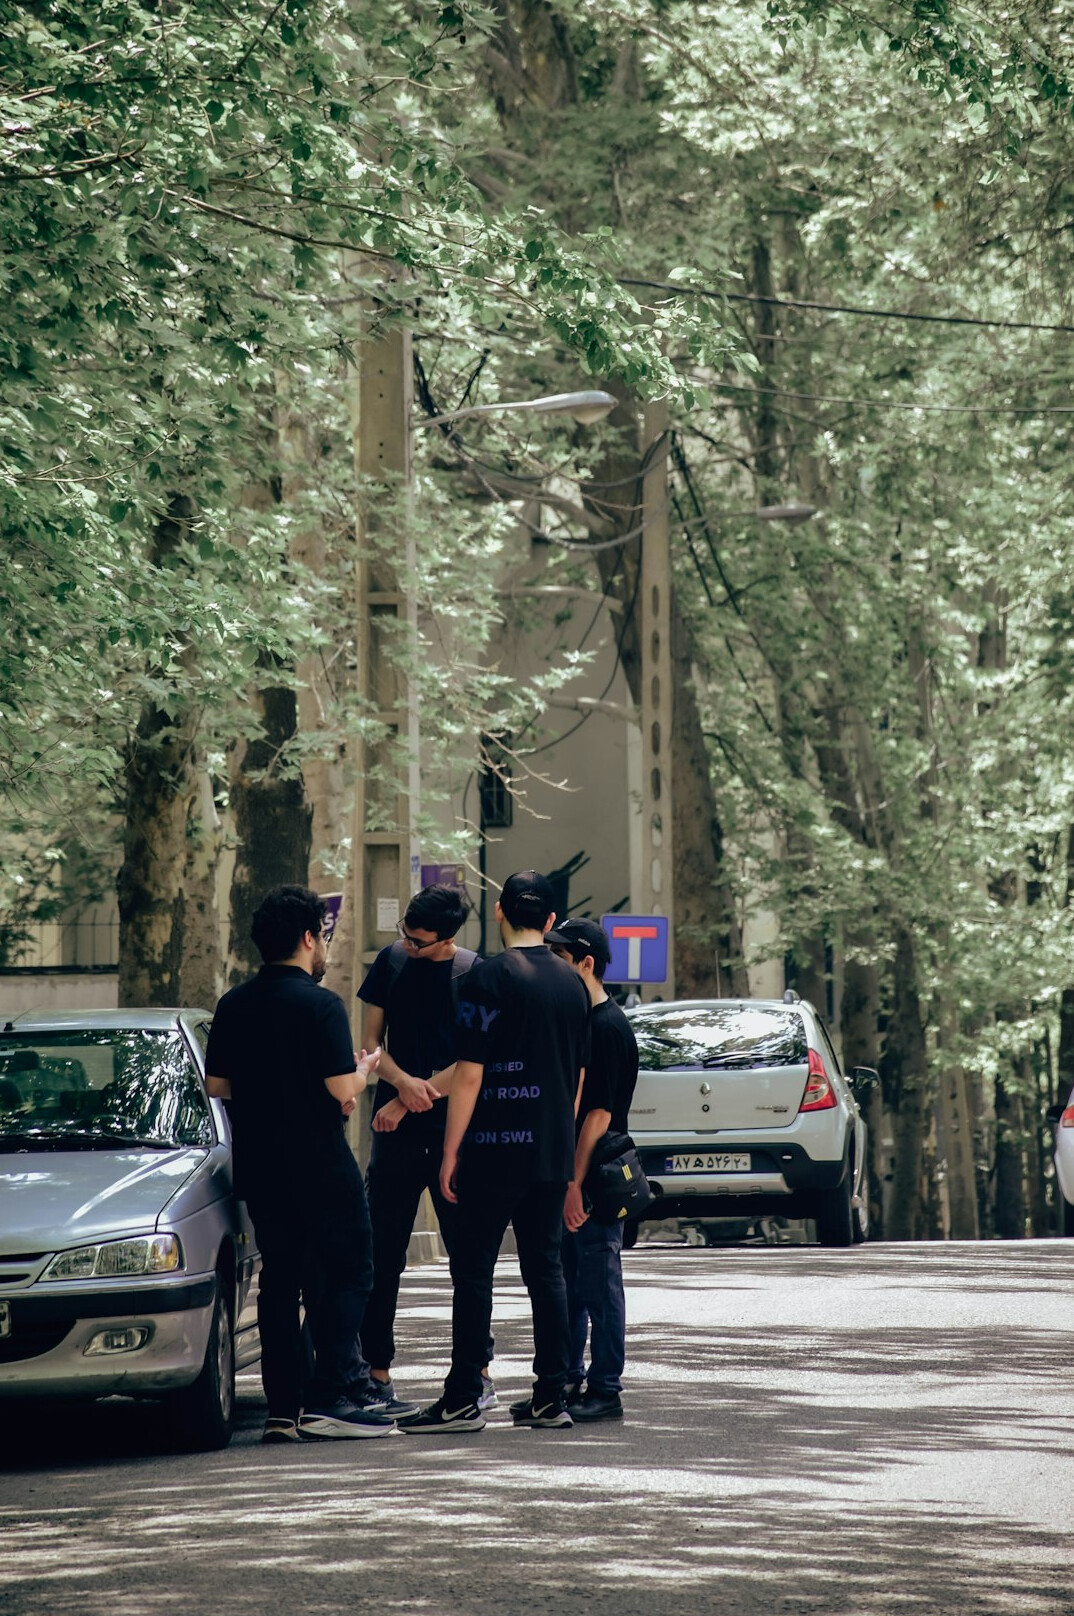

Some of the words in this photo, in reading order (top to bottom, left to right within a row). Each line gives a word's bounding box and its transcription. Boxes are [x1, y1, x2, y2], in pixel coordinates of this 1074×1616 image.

[497, 1085, 541, 1100] ROAD
[474, 1131, 497, 1144] ON
[500, 1130, 534, 1144] SW1
